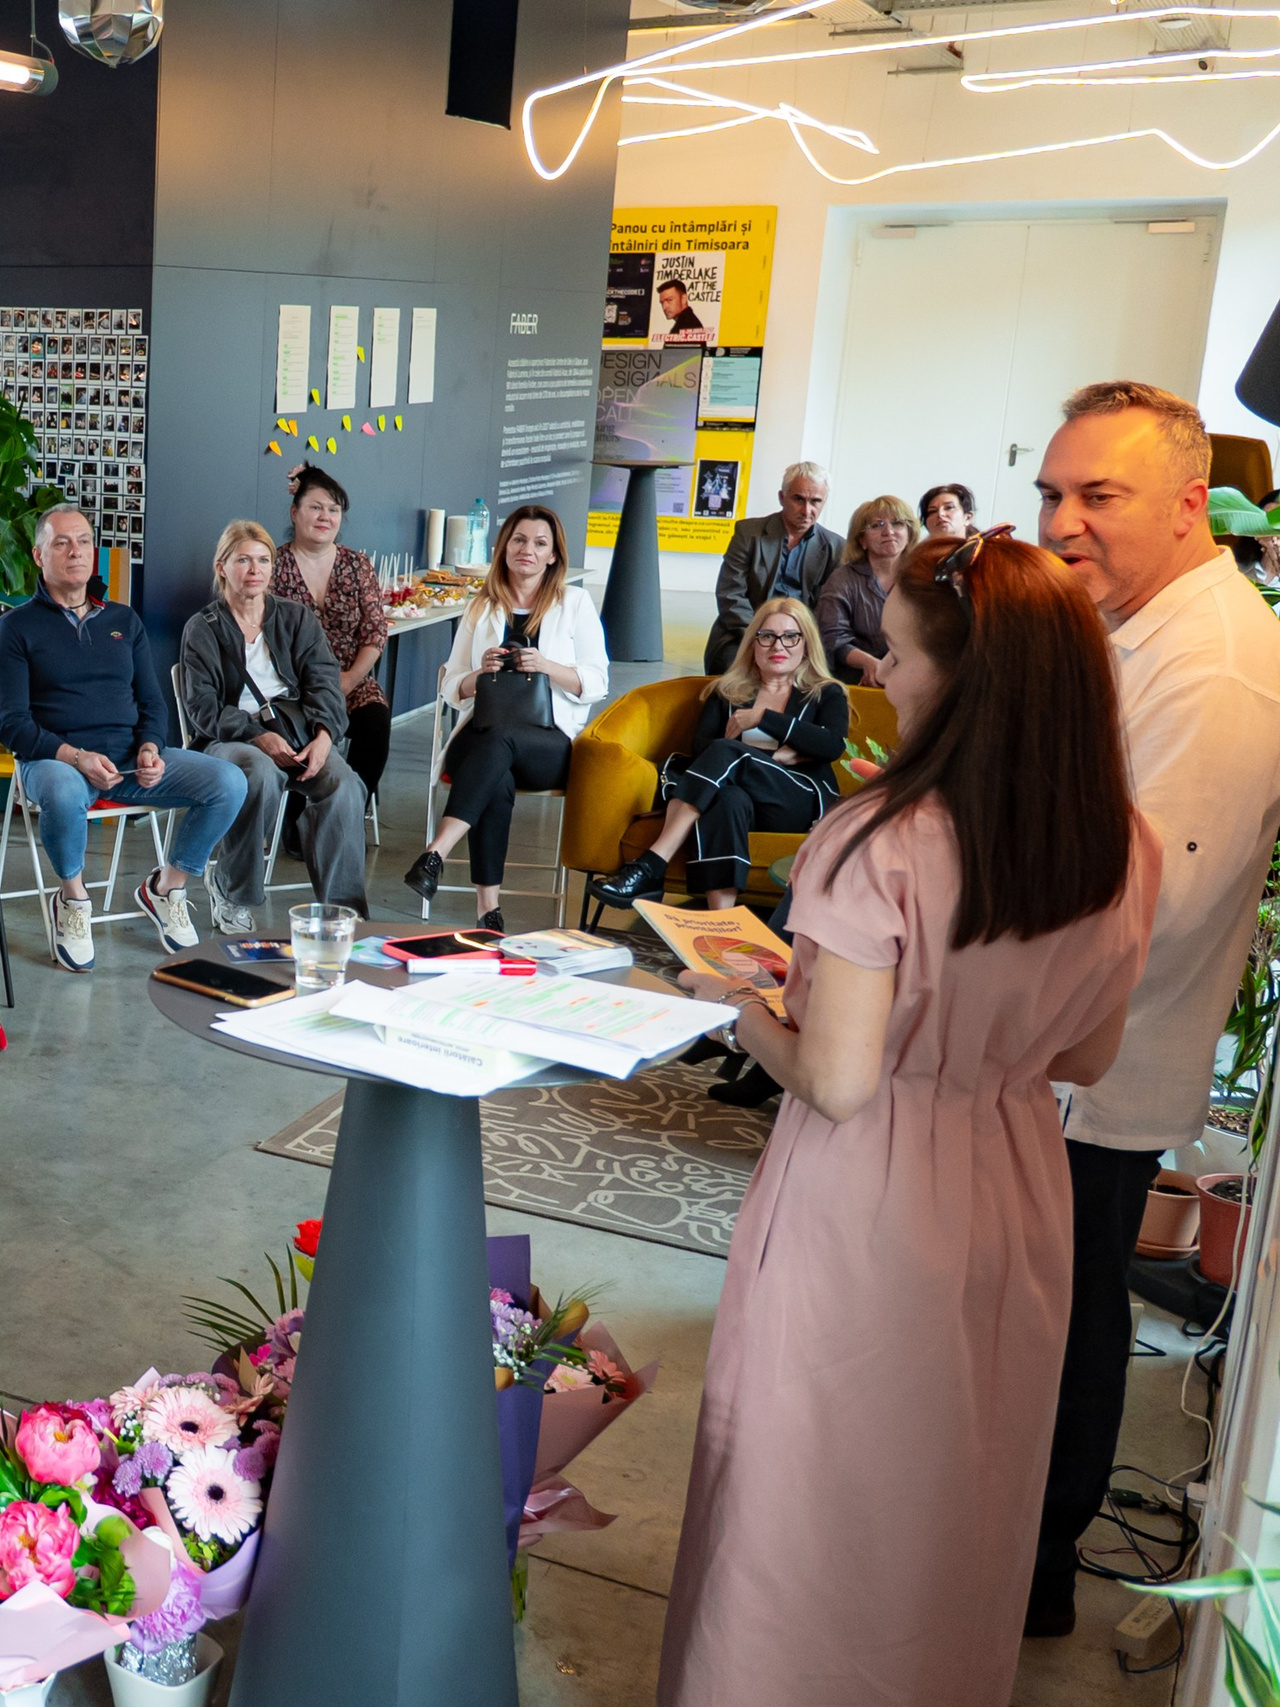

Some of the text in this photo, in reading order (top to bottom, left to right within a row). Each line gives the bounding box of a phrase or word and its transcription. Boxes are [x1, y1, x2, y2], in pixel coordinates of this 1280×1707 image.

[610, 220, 752, 236] Panou cu întâmplări și
[662, 239, 681, 251] din
[662, 256, 695, 269] JUSTIN
[656, 266, 718, 280] TIMBERLAKE
[687, 280, 717, 291] AT THE
[688, 290, 722, 302] CASTLE
[510, 312, 538, 334] FABER
[600, 352, 662, 370] ESIGN
